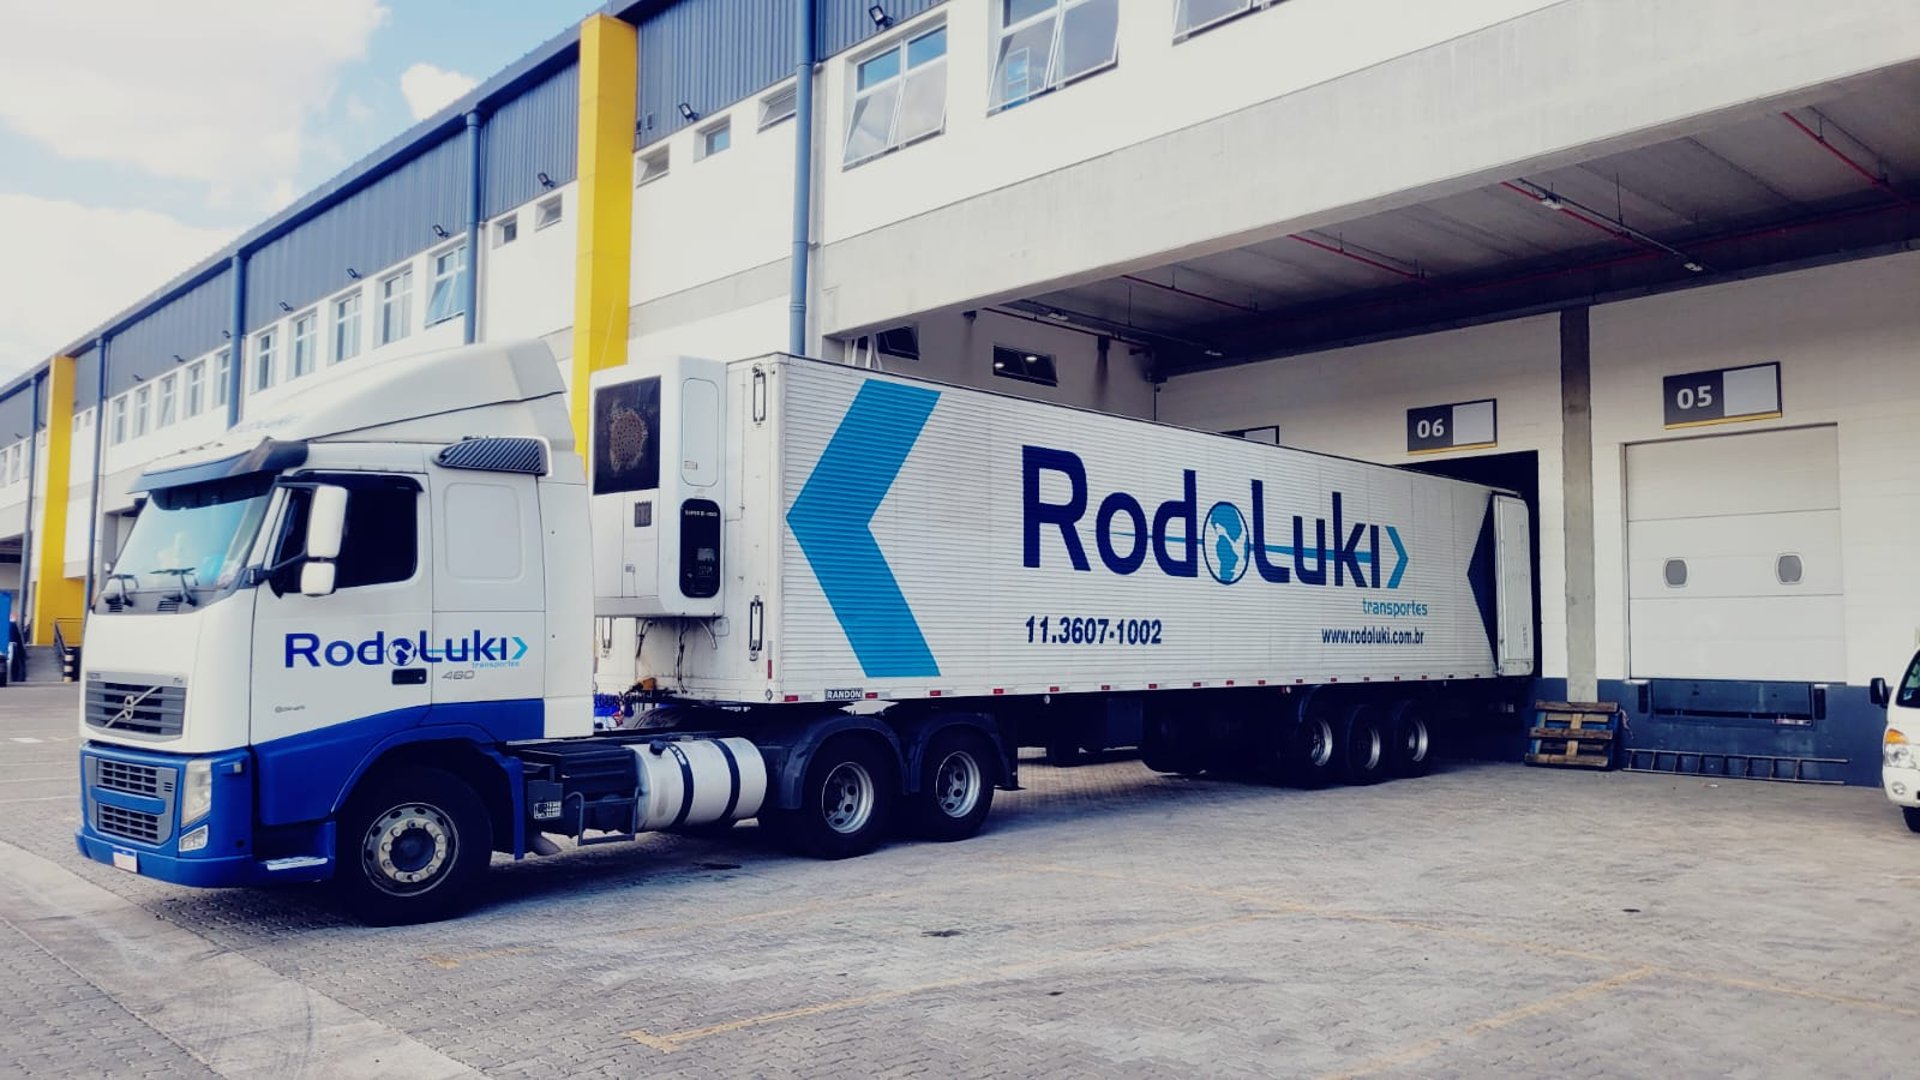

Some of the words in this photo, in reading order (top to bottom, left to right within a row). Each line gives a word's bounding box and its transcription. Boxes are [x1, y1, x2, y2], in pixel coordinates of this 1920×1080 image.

[1677, 385, 1712, 410] 05
[1417, 418, 1444, 438] 06
[1362, 598, 1428, 619] transportes
[1025, 615, 1162, 645] 11.3607-1002
[1321, 626, 1425, 645] www.rodoluki.com.br
[827, 690, 861, 699] RANDON
